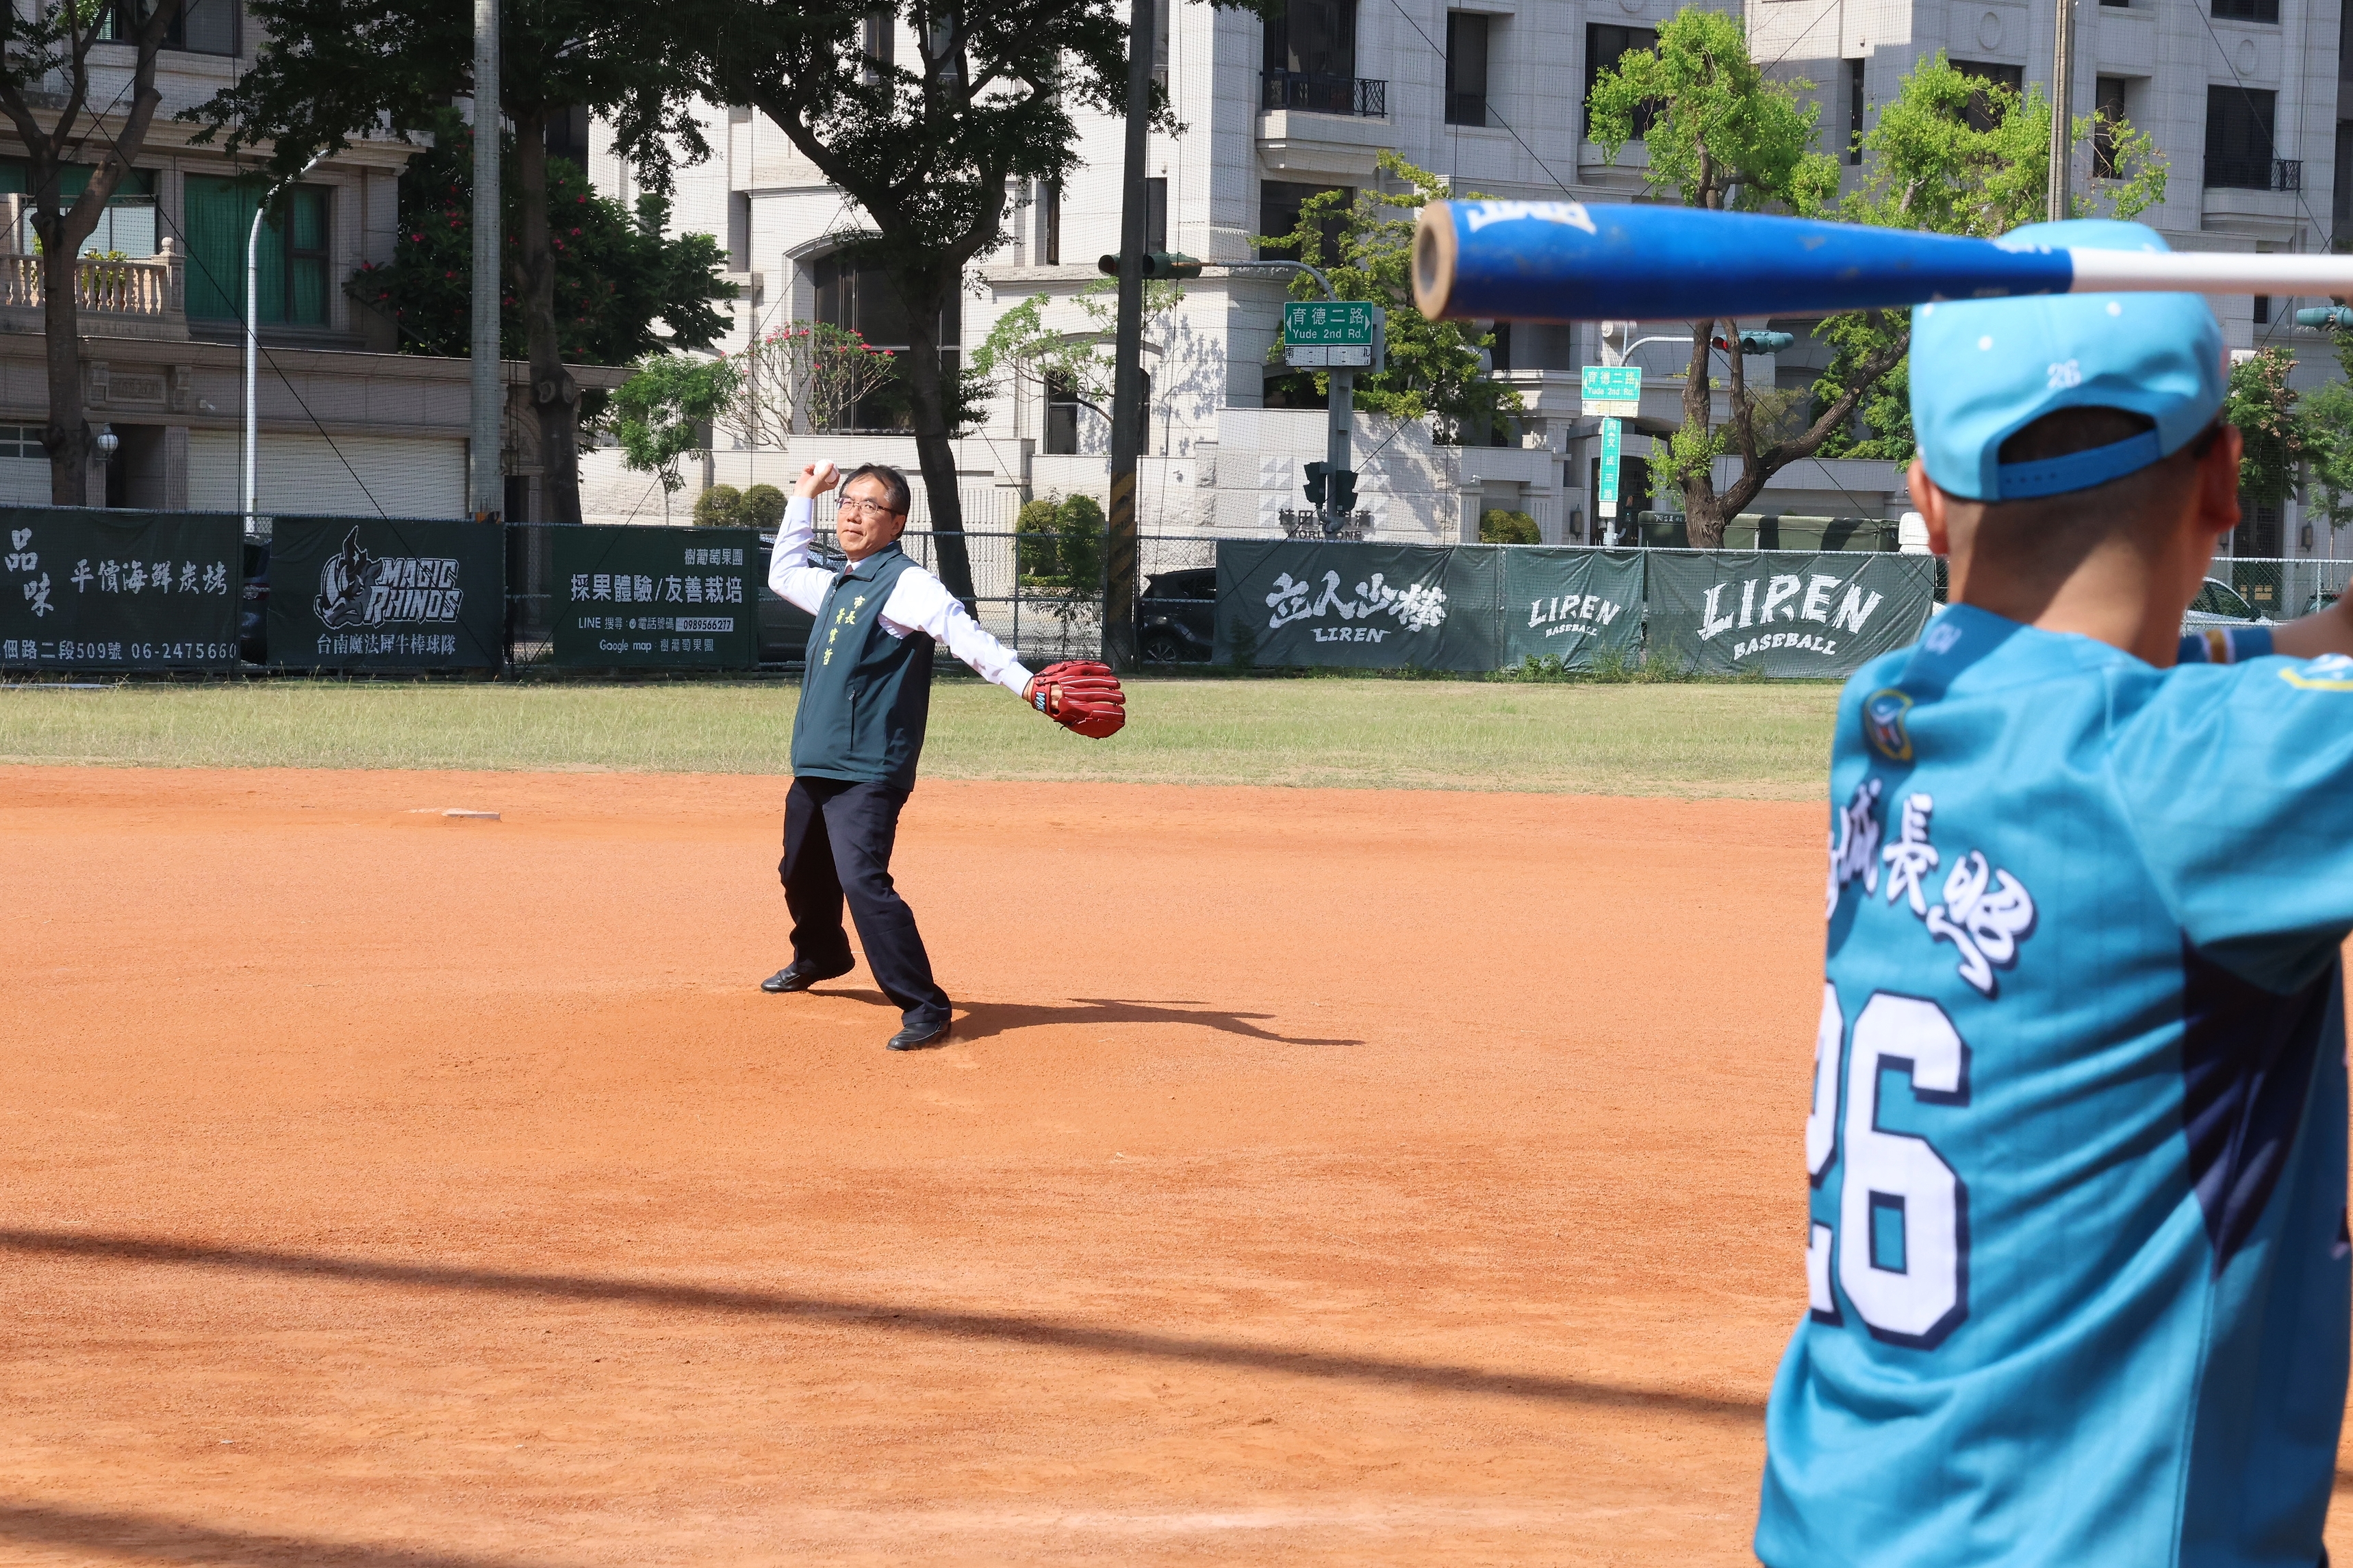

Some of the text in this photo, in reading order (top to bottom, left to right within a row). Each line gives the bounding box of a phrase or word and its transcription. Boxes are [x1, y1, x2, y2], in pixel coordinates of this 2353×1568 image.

[1293, 307, 1364, 325] 育德二路
[1293, 329, 1364, 339] Yude 2nd Rd.
[1285, 346, 1294, 359] 南
[1588, 370, 1635, 385] 育德二路
[2046, 358, 2082, 389] 26
[1588, 387, 1604, 395] Yude
[1607, 387, 1620, 396] 2nd
[1603, 438, 1616, 500] 文成三路
[685, 548, 743, 565] 樹葡萄果園
[4, 527, 54, 617] 品味
[70, 558, 227, 595] 平價海鮮炭烤
[377, 558, 458, 589] MAGIC
[570, 574, 742, 604] 採果體驗/友善栽培
[363, 585, 463, 628] RHINOS
[845, 595, 866, 624] 市長
[1527, 595, 1621, 628] LIREN
[1697, 574, 1884, 641] LIREN
[578, 617, 601, 628] LINE
[637, 617, 674, 630] 電話號碼
[1545, 624, 1597, 638] BASEBALL
[317, 633, 456, 654] 台南魔法犀牛棒球隊
[1310, 627, 1390, 643] LIREN
[131, 643, 237, 659] 06-2475660
[599, 638, 628, 654] Google
[1733, 632, 1837, 660] BASEBALL
